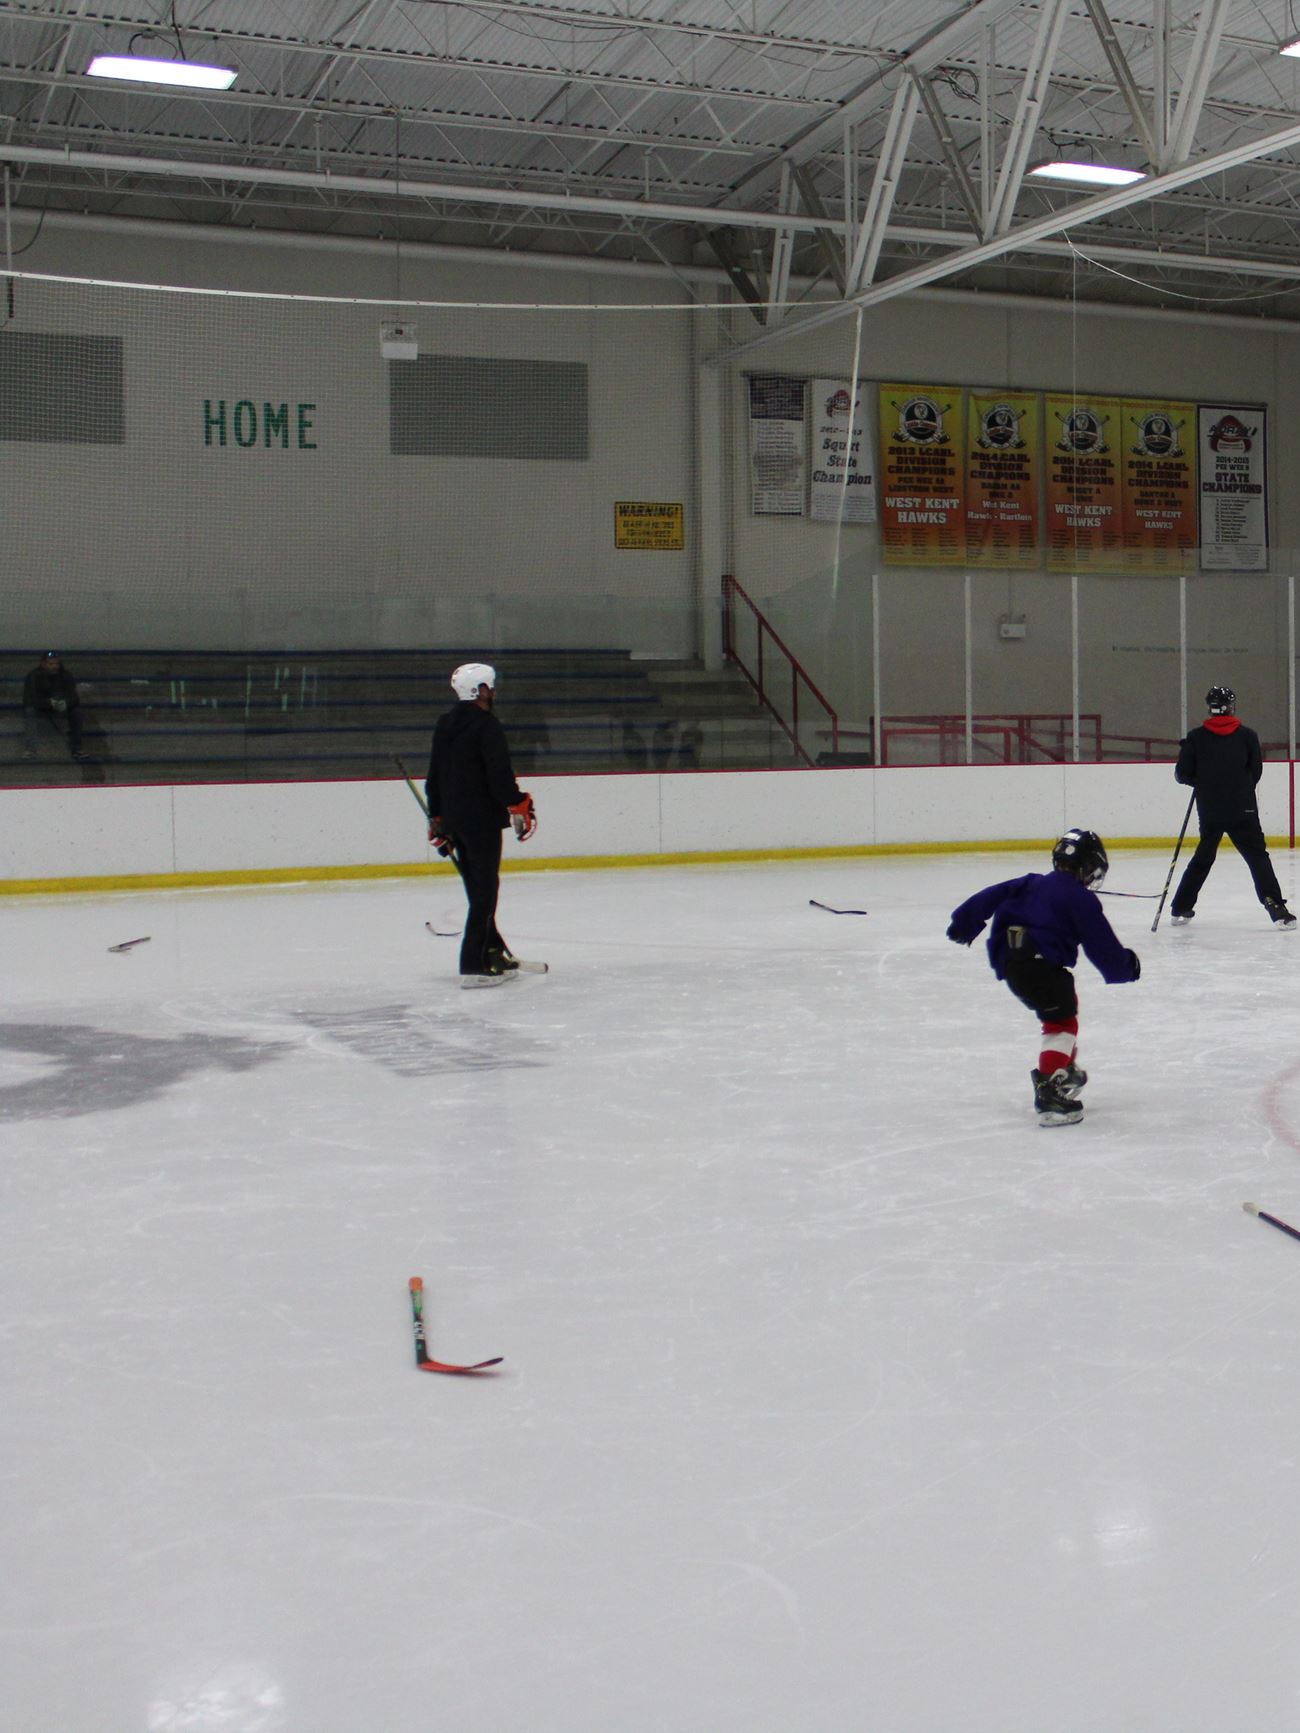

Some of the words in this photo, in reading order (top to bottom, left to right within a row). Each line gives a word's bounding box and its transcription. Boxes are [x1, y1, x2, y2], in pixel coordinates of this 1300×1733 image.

[204, 399, 318, 449] HOME
[887, 465, 956, 477] CHAMPIONS
[1214, 472, 1250, 483] STATE
[1202, 483, 1262, 495] CHAMPIONS
[885, 496, 921, 509] WEST
[925, 498, 961, 510] KENT
[999, 500, 1020, 511] Kent
[619, 504, 679, 518] WARNING!
[1055, 503, 1082, 515] WEST
[1084, 505, 1113, 517] KENT
[1136, 509, 1160, 520] WEST
[1161, 510, 1183, 520] KENT
[897, 510, 948, 525] HAWKS
[1066, 516, 1102, 528] HAWKS
[1144, 520, 1173, 531] HAWKS
